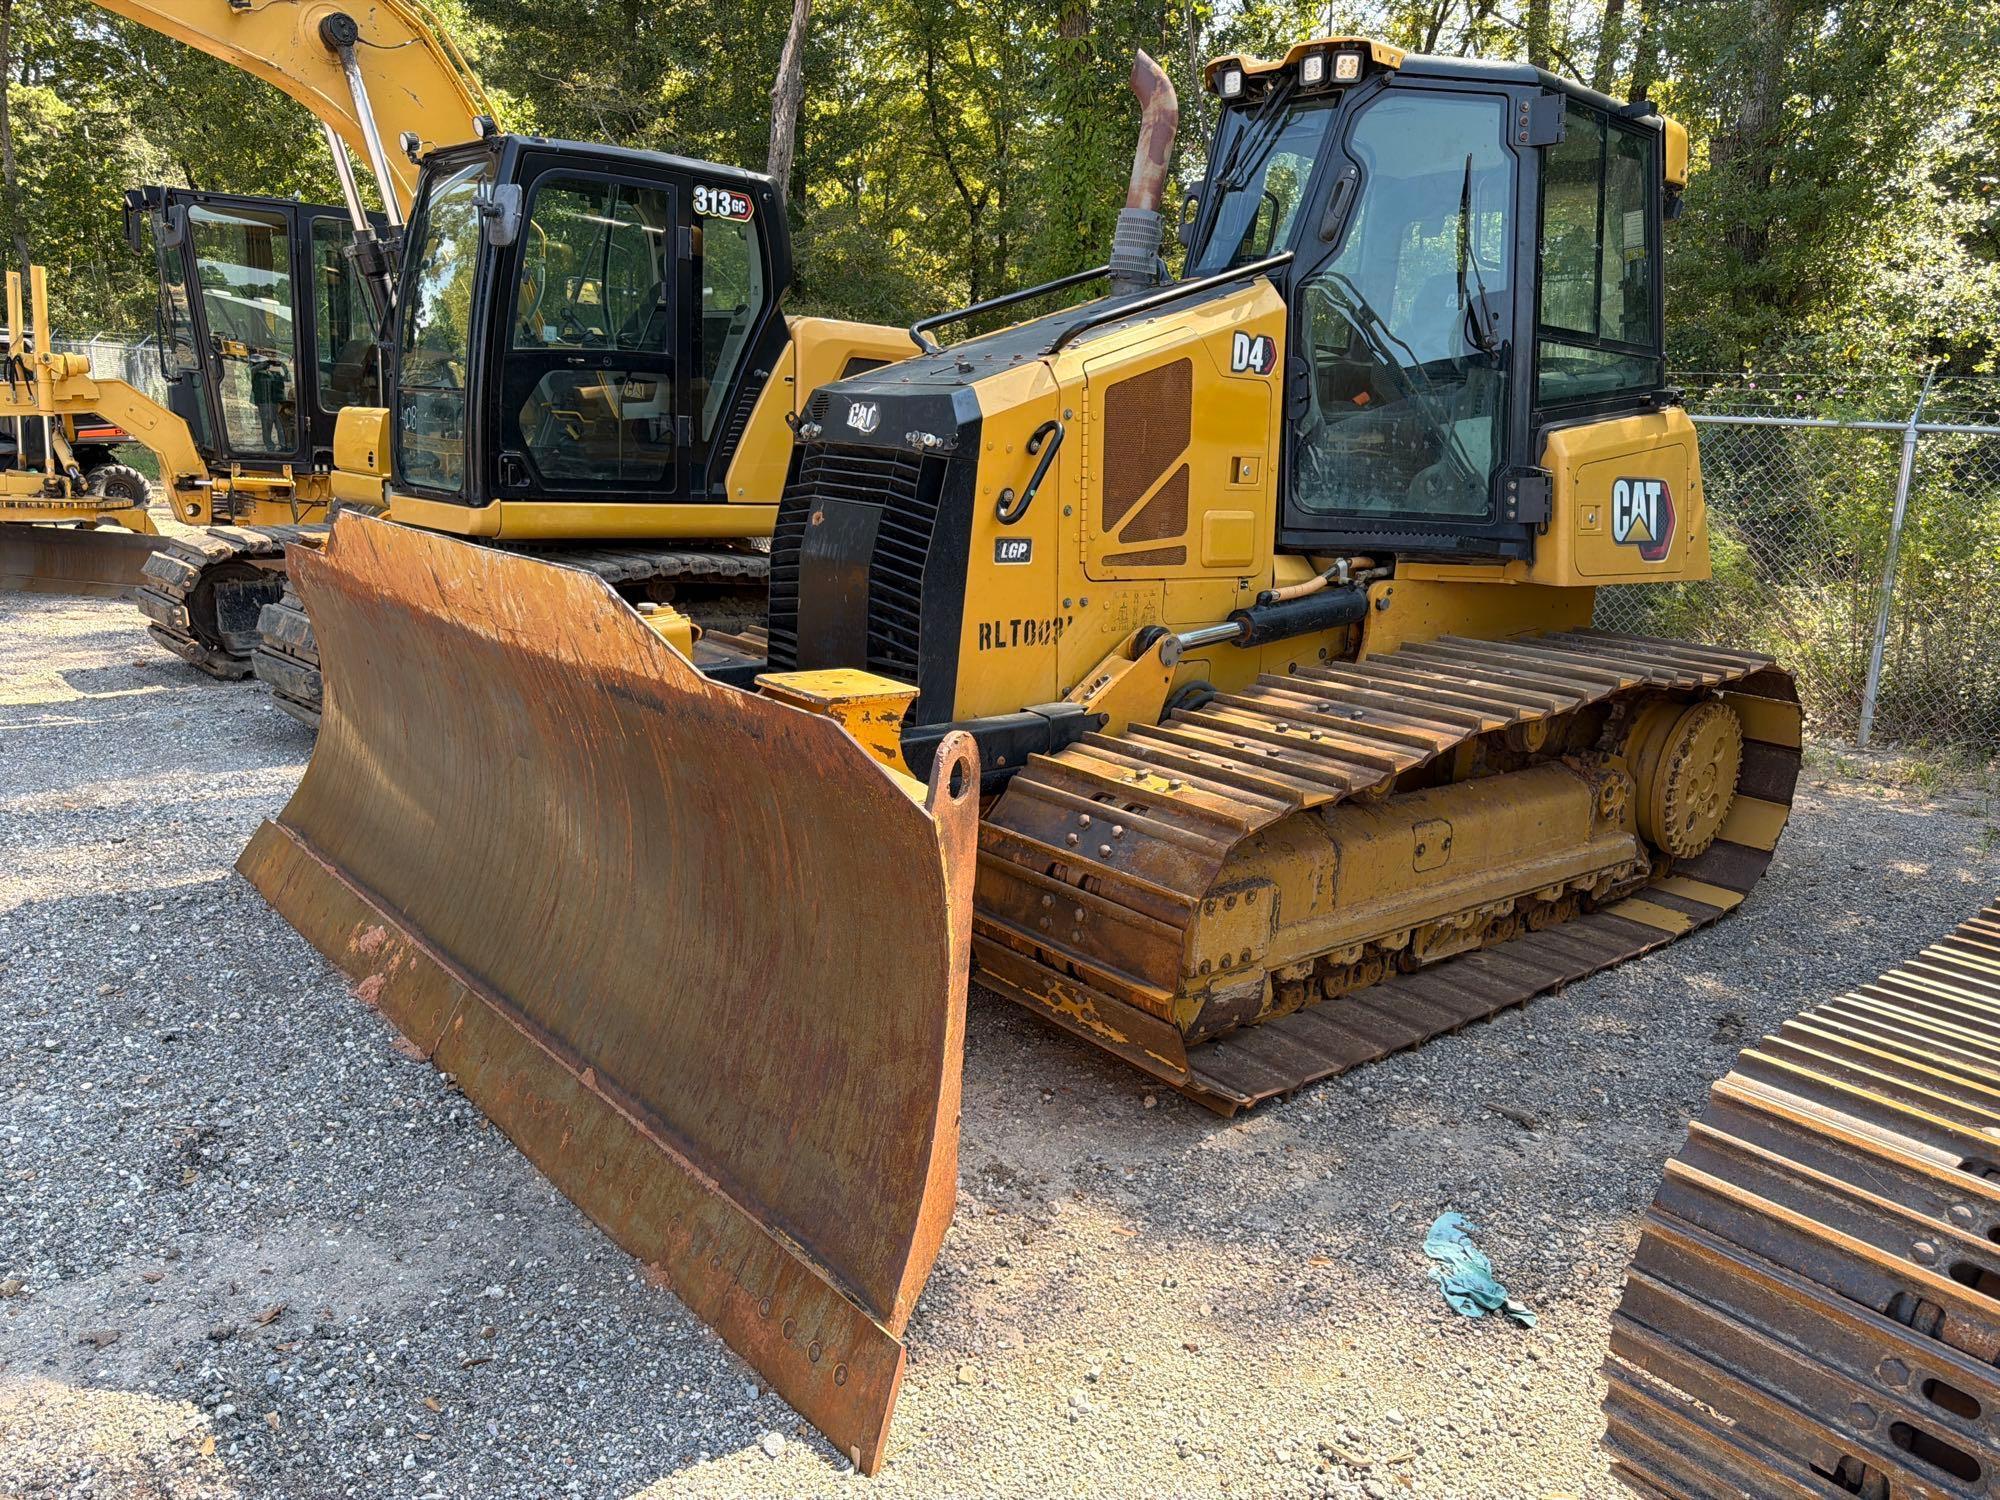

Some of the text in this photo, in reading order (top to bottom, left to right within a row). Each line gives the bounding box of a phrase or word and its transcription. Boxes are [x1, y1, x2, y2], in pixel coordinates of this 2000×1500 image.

[695, 187, 746, 216] 313 GC
[1232, 333, 1264, 372] D4
[847, 402, 877, 429] CAT
[1613, 480, 1661, 542] CAT
[1000, 542, 1028, 559] LGP
